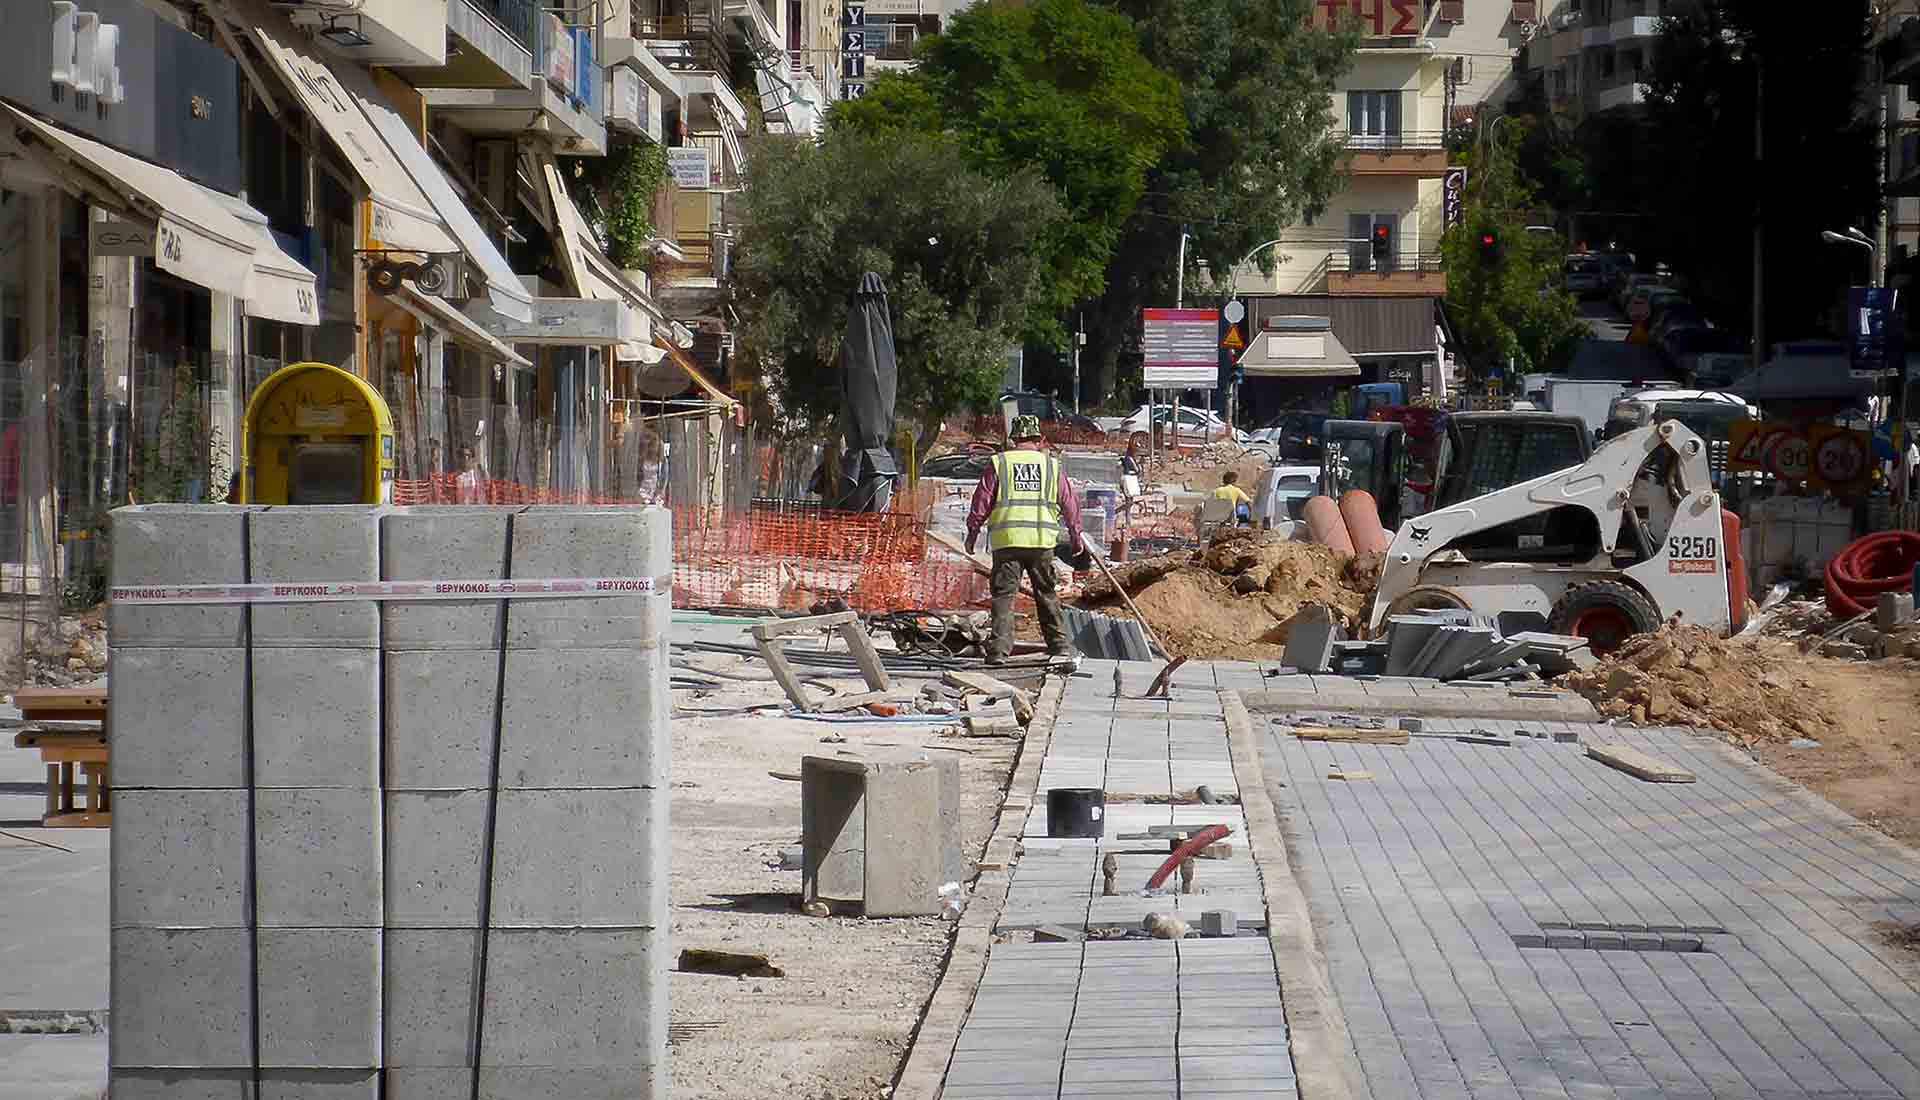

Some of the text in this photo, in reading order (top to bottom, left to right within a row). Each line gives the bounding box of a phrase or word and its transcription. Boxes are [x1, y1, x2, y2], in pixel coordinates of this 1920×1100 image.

[1303, 0, 1418, 34] ΤΗΣ
[97, 232, 150, 247] GA
[1669, 536, 1716, 558] S250
[111, 588, 167, 600] ΒΕΡΥΚΟΚΟΣ
[273, 586, 329, 596] ΒΕΡΥΚΟΚΟΣ
[435, 583, 490, 594] ΒΕΡΥΚΟΚΟΣ
[596, 580, 650, 591] ΒΕΡΥΚΟΚΟΣ
